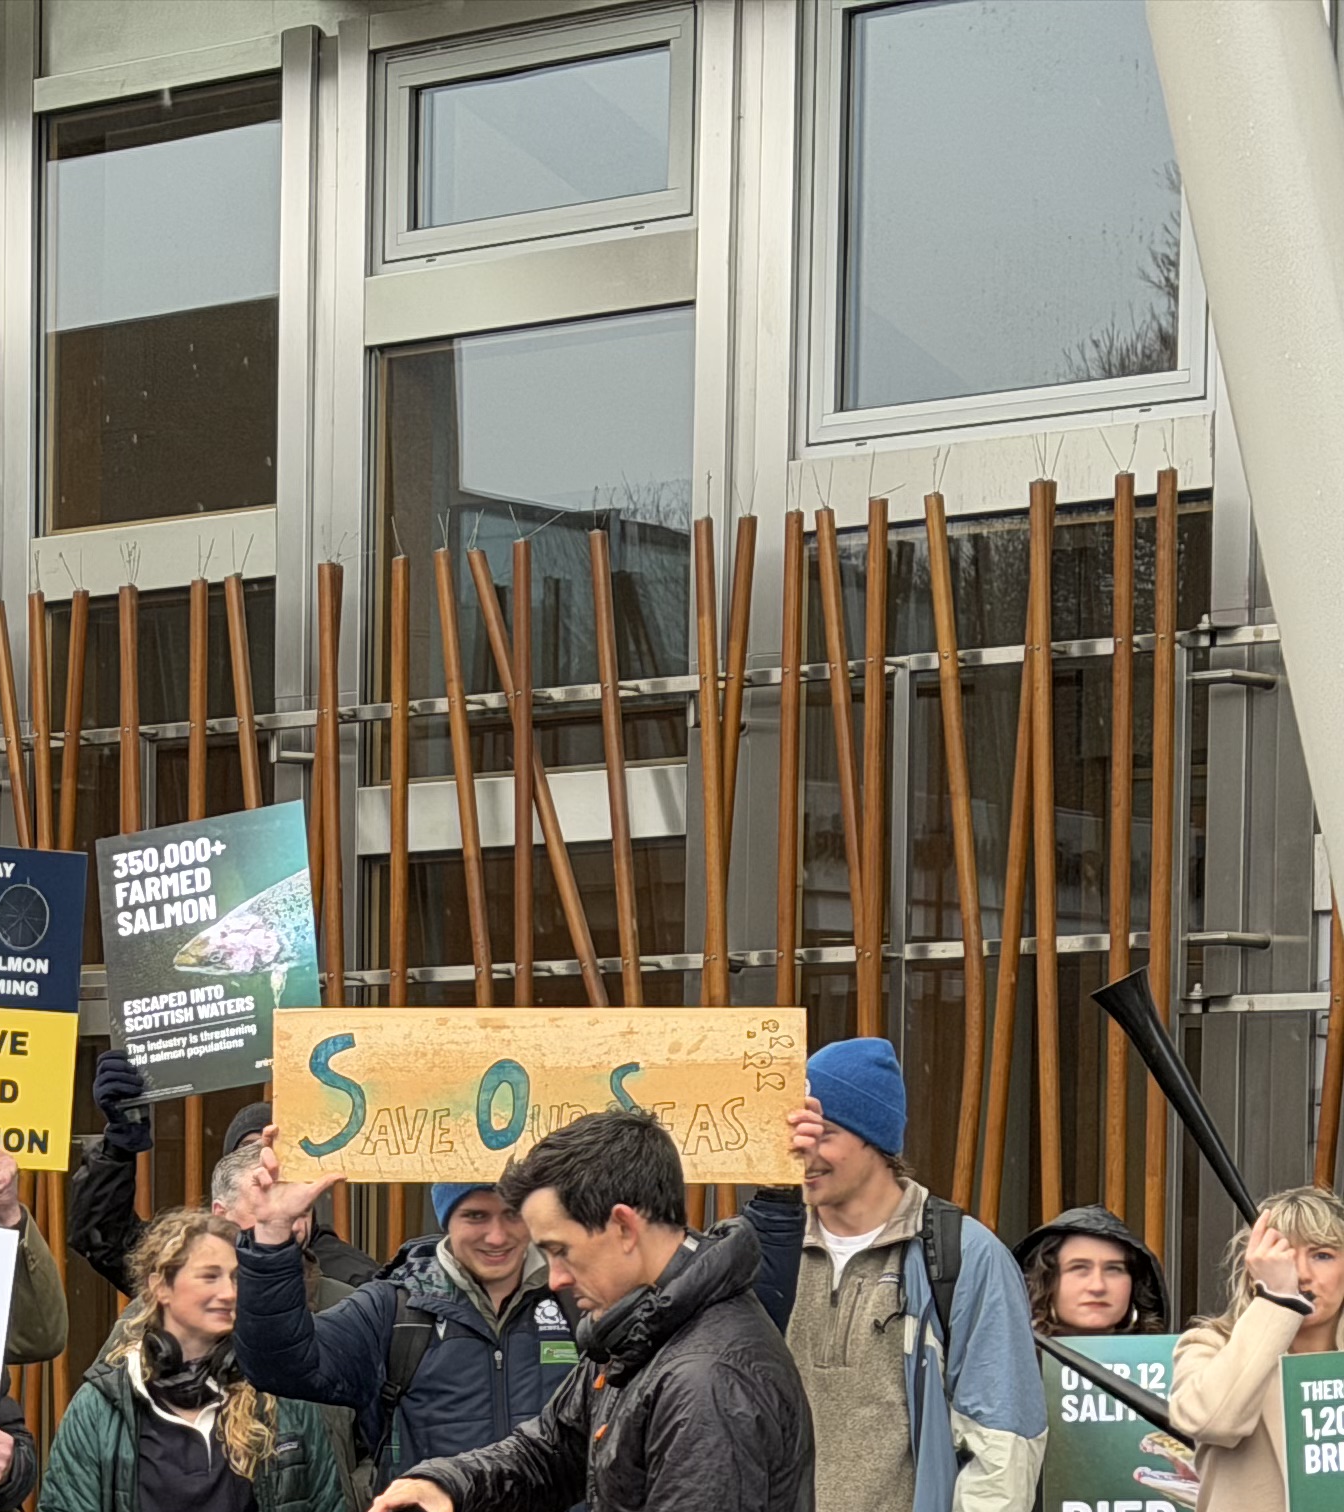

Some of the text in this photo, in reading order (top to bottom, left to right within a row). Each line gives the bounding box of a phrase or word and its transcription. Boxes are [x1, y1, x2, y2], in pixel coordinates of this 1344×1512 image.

[112, 837, 227, 879] 350,000+
[115, 867, 211, 908] FARMED
[117, 895, 217, 936] SALMON
[123, 984, 224, 1016] ESCAPED INTO
[125, 996, 255, 1033] SCOTTISH WATERS
[126, 1023, 257, 1056] The industry is threatening
[150, 1037, 245, 1062] salmon populations
[299, 1032, 453, 1157] SAVE
[1137, 1362, 1166, 1389] 12
